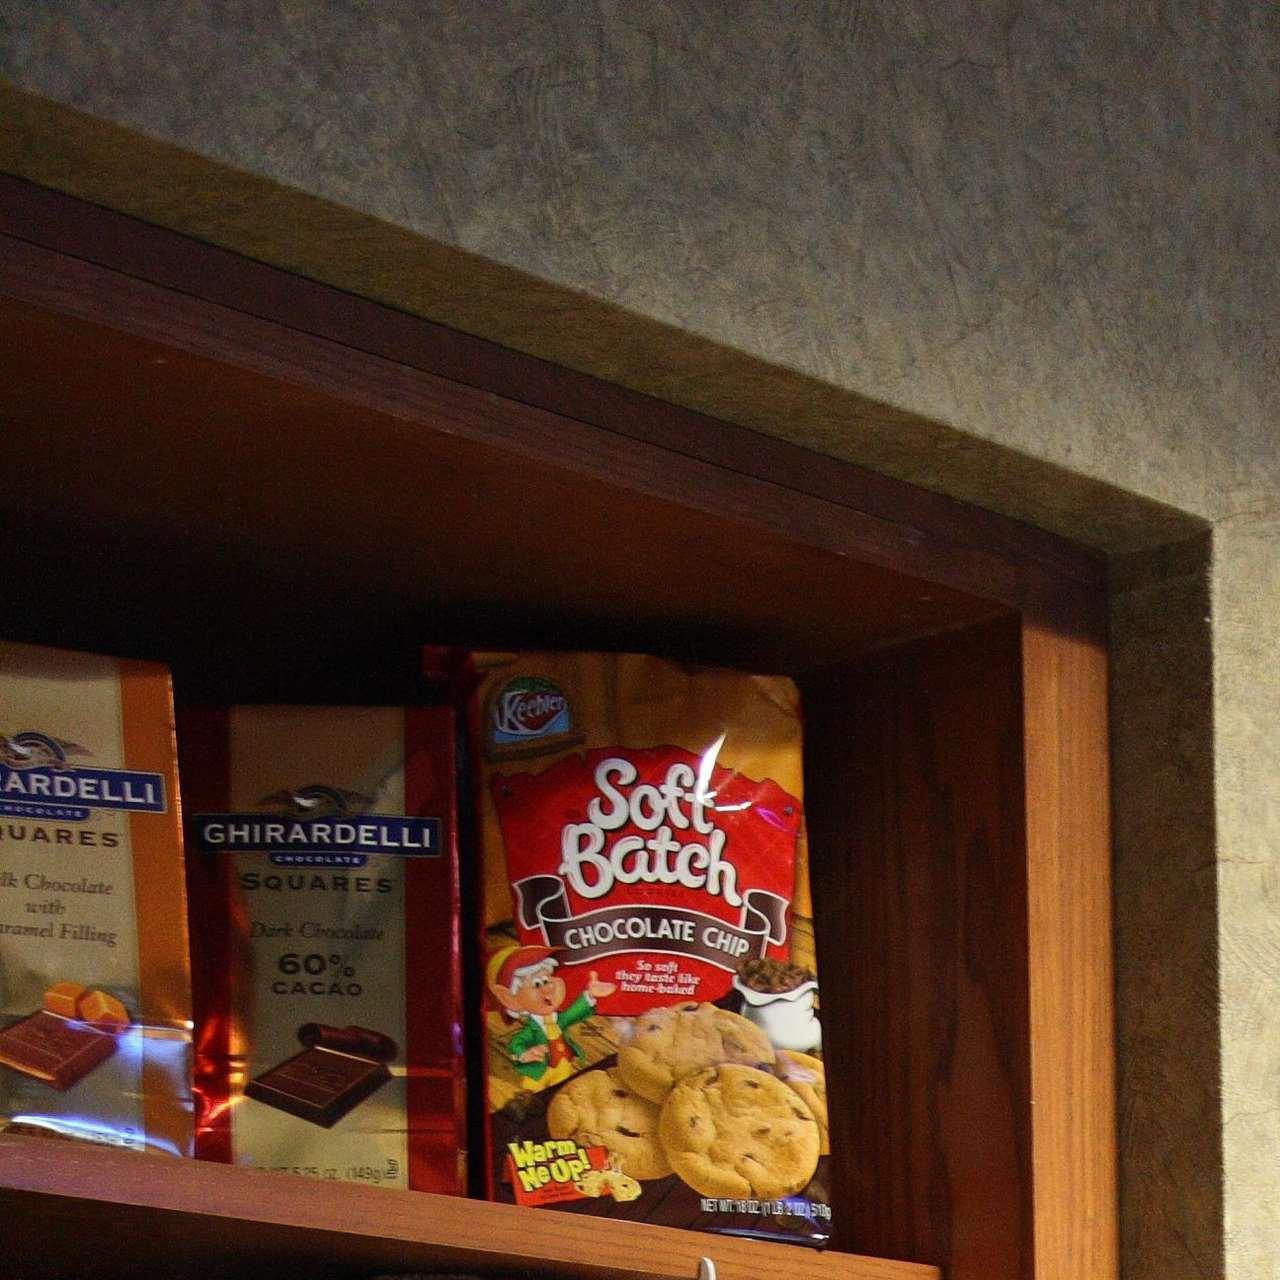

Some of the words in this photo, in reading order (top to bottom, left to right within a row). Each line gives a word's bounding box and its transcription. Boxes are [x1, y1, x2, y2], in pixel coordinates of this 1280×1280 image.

[588, 758, 716, 834] Soft
[204, 822, 431, 849] GHIRARDELLI
[559, 823, 743, 907] Batch
[24, 873, 114, 896] Chocolate
[242, 872, 394, 894] SQUARES
[24, 900, 67, 915] with
[60, 923, 118, 947] Filling
[564, 917, 696, 949] CHOCOLATE
[702, 926, 750, 959] CHIP
[278, 953, 358, 978] 60%
[273, 982, 363, 997] CACAO
[506, 1139, 577, 1168] Warm
